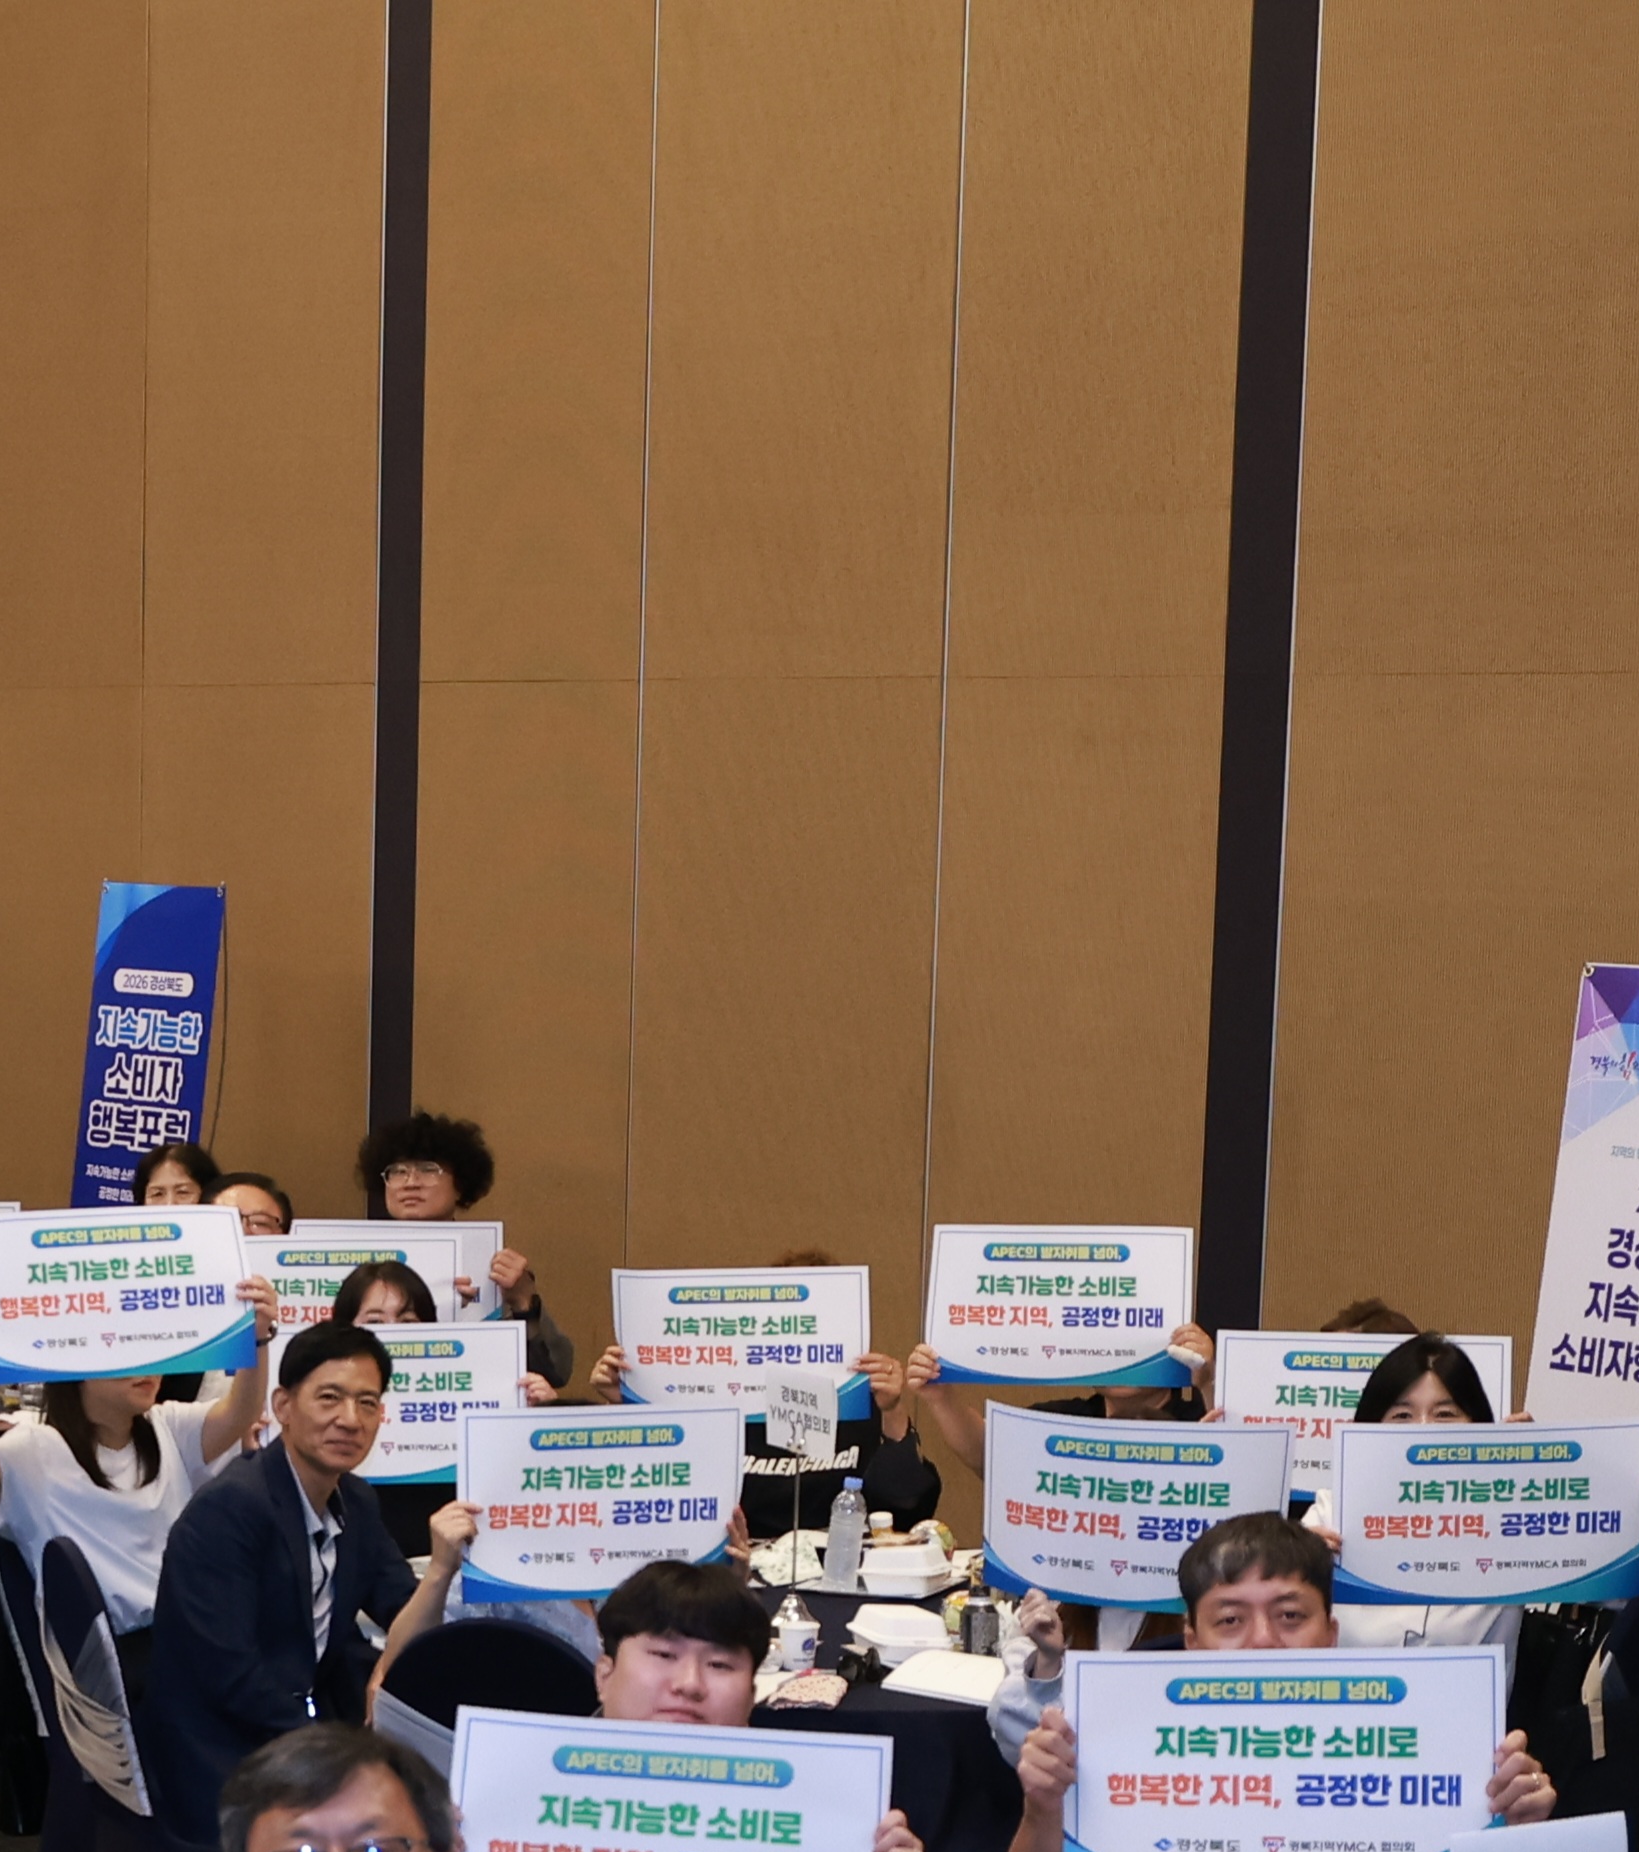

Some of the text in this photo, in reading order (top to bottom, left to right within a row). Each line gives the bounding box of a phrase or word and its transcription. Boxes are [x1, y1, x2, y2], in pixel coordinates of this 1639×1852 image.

[122, 974, 149, 989] 2026
[96, 1004, 203, 1055] 지속가능한
[103, 1051, 184, 1104] 소비자
[86, 1099, 190, 1153] 행복포럼
[976, 1274, 1137, 1298] 지속가능한 소비로
[946, 1303, 1163, 1328] 행복한 지역, 공정한 미래
[1179, 1679, 1392, 1700] APEC의 발자취를 넘어,
[1155, 1725, 1418, 1759] 지속가능한 소비로
[1107, 1772, 1461, 1808] 행복한 지역, 공정한 미래
